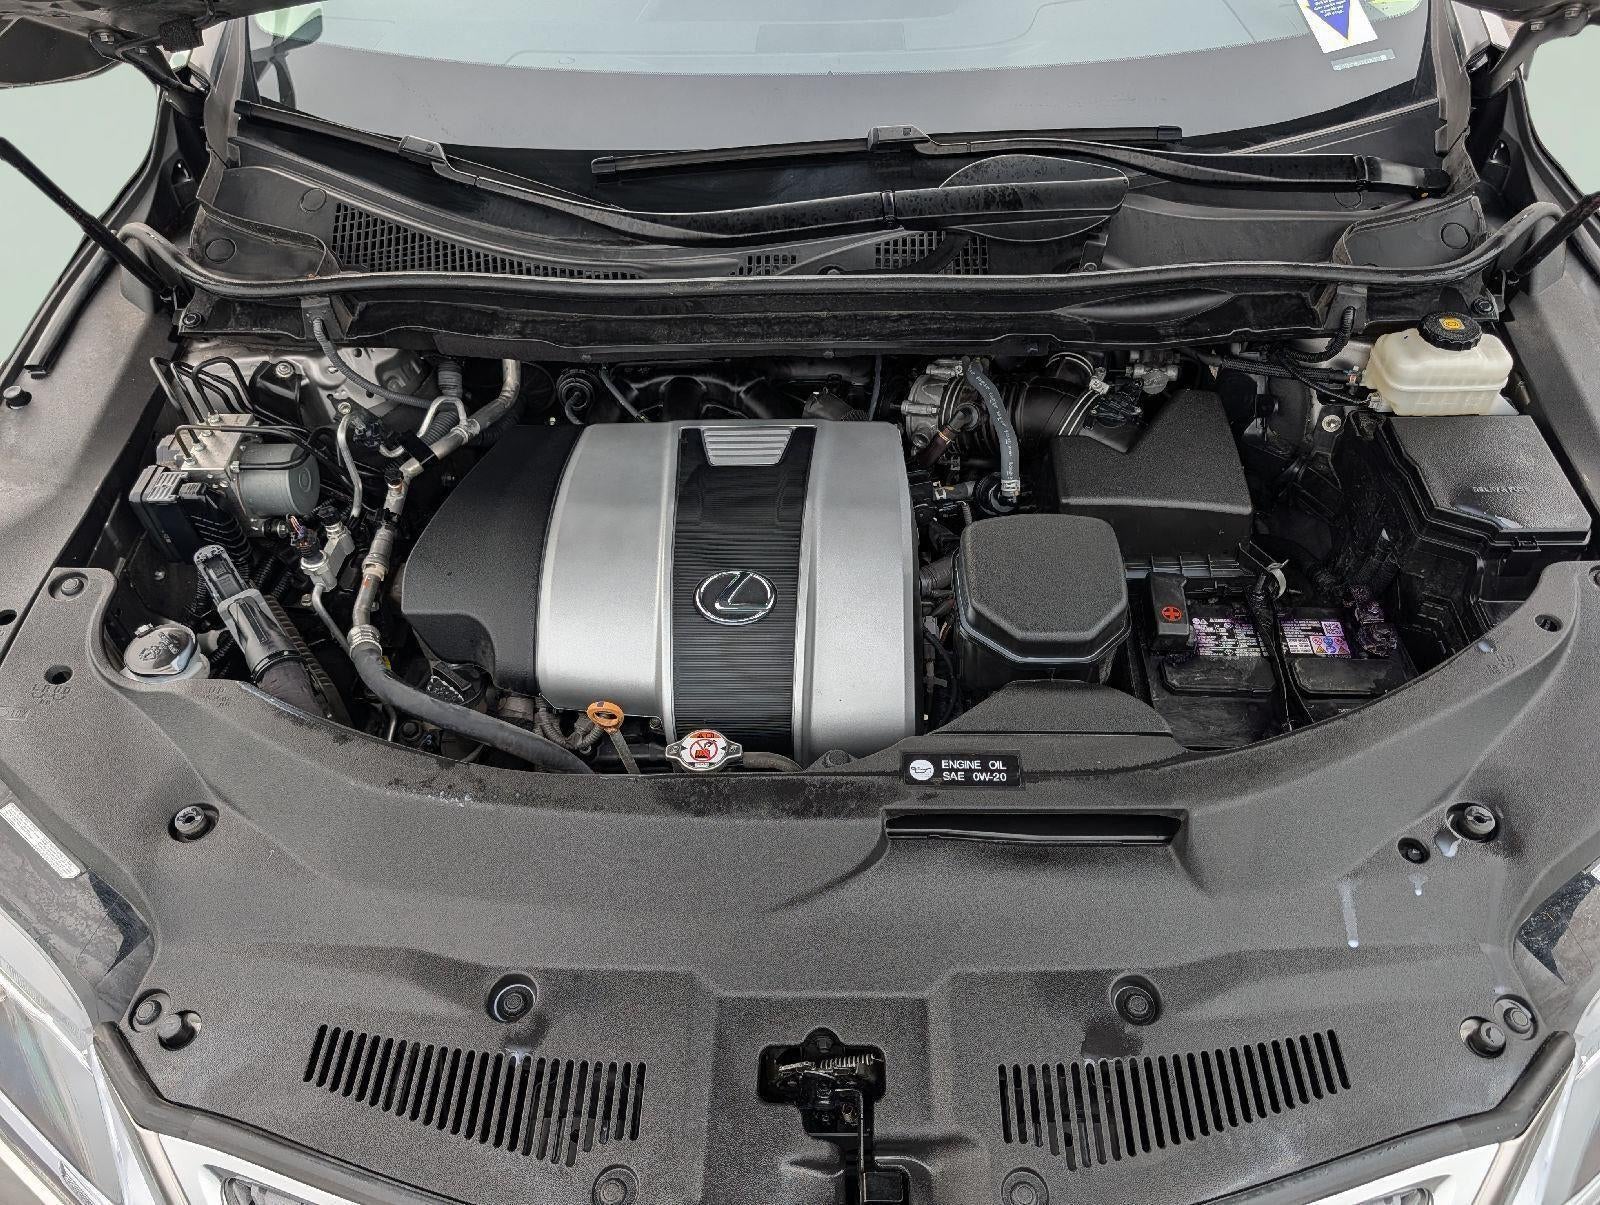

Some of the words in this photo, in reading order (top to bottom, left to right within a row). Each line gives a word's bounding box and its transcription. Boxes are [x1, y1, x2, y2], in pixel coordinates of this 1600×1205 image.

[941, 759, 982, 769] ENGINE
[988, 760, 1007, 770] OIL
[942, 771, 965, 781] SAE
[972, 772, 1007, 782] 0W-20
